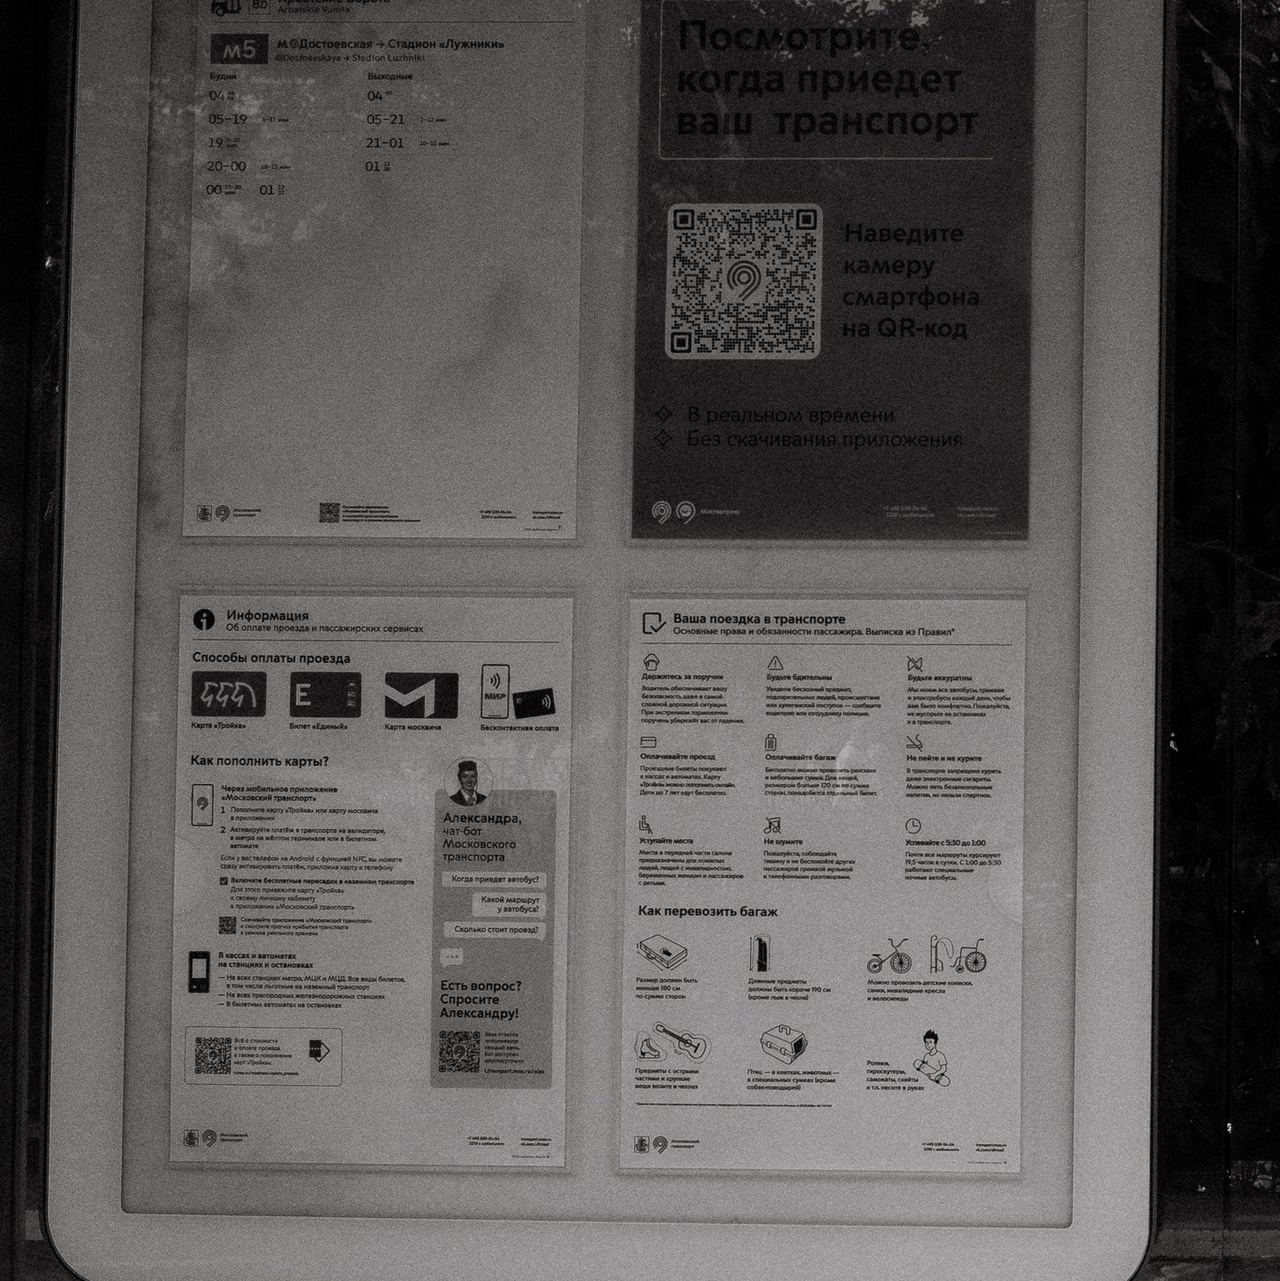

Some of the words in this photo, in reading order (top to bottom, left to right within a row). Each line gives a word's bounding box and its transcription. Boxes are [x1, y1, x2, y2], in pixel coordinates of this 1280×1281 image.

[679, 19, 930, 57] Посмотрите,
[299, 39, 372, 50] Достоевская
[388, 39, 436, 49] Стадион
[439, 39, 504, 50] «Лужники»
[210, 72, 237, 81] Будни
[368, 73, 413, 81] Выходные
[677, 70, 784, 97] когда
[798, 70, 962, 100] приедет
[209, 90, 225, 101] 04
[367, 91, 383, 101] 04
[677, 112, 752, 136] ваш
[774, 112, 979, 142] транспорт
[208, 138, 223, 149] 19
[365, 161, 381, 172] 01
[206, 184, 222, 195] 00
[259, 185, 275, 195] 01
[844, 223, 964, 245] Наведите
[843, 260, 935, 279] камеру
[843, 287, 980, 310] смартфона
[843, 323, 870, 337] на
[878, 318, 968, 340] QR-код
[687, 406, 700, 422] В
[706, 410, 802, 425] реальном
[809, 410, 895, 425] времени
[687, 430, 721, 447] Без
[727, 435, 836, 447] скачивания
[843, 434, 963, 450] приложения
[226, 610, 309, 622] Информация
[673, 613, 706, 623] Ваша
[710, 616, 761, 625] поездка
[774, 616, 846, 626] транспорте
[226, 623, 239, 631] Об
[756, 627, 812, 635] обязанности
[814, 629, 863, 637] пассажира.
[192, 652, 247, 662] Способы
[251, 655, 296, 663] оплаты
[300, 655, 351, 664] проезда
[907, 674, 932, 682] Будьте
[190, 755, 213, 765] Как
[217, 758, 282, 766] пополнить
[285, 756, 329, 768] карты?
[443, 812, 522, 825] Александра,
[443, 826, 482, 836] чат-бот
[442, 839, 517, 849] Московского
[442, 853, 506, 863] транспорта
[508, 876, 539, 884] автобус?
[638, 906, 661, 916] Как
[664, 908, 737, 918] перевозить
[740, 906, 779, 917] багаж
[440, 980, 468, 990] Есть
[471, 981, 522, 992] вопрос?
[440, 994, 500, 1006] Спросите
[440, 1007, 519, 1021] Александру!
